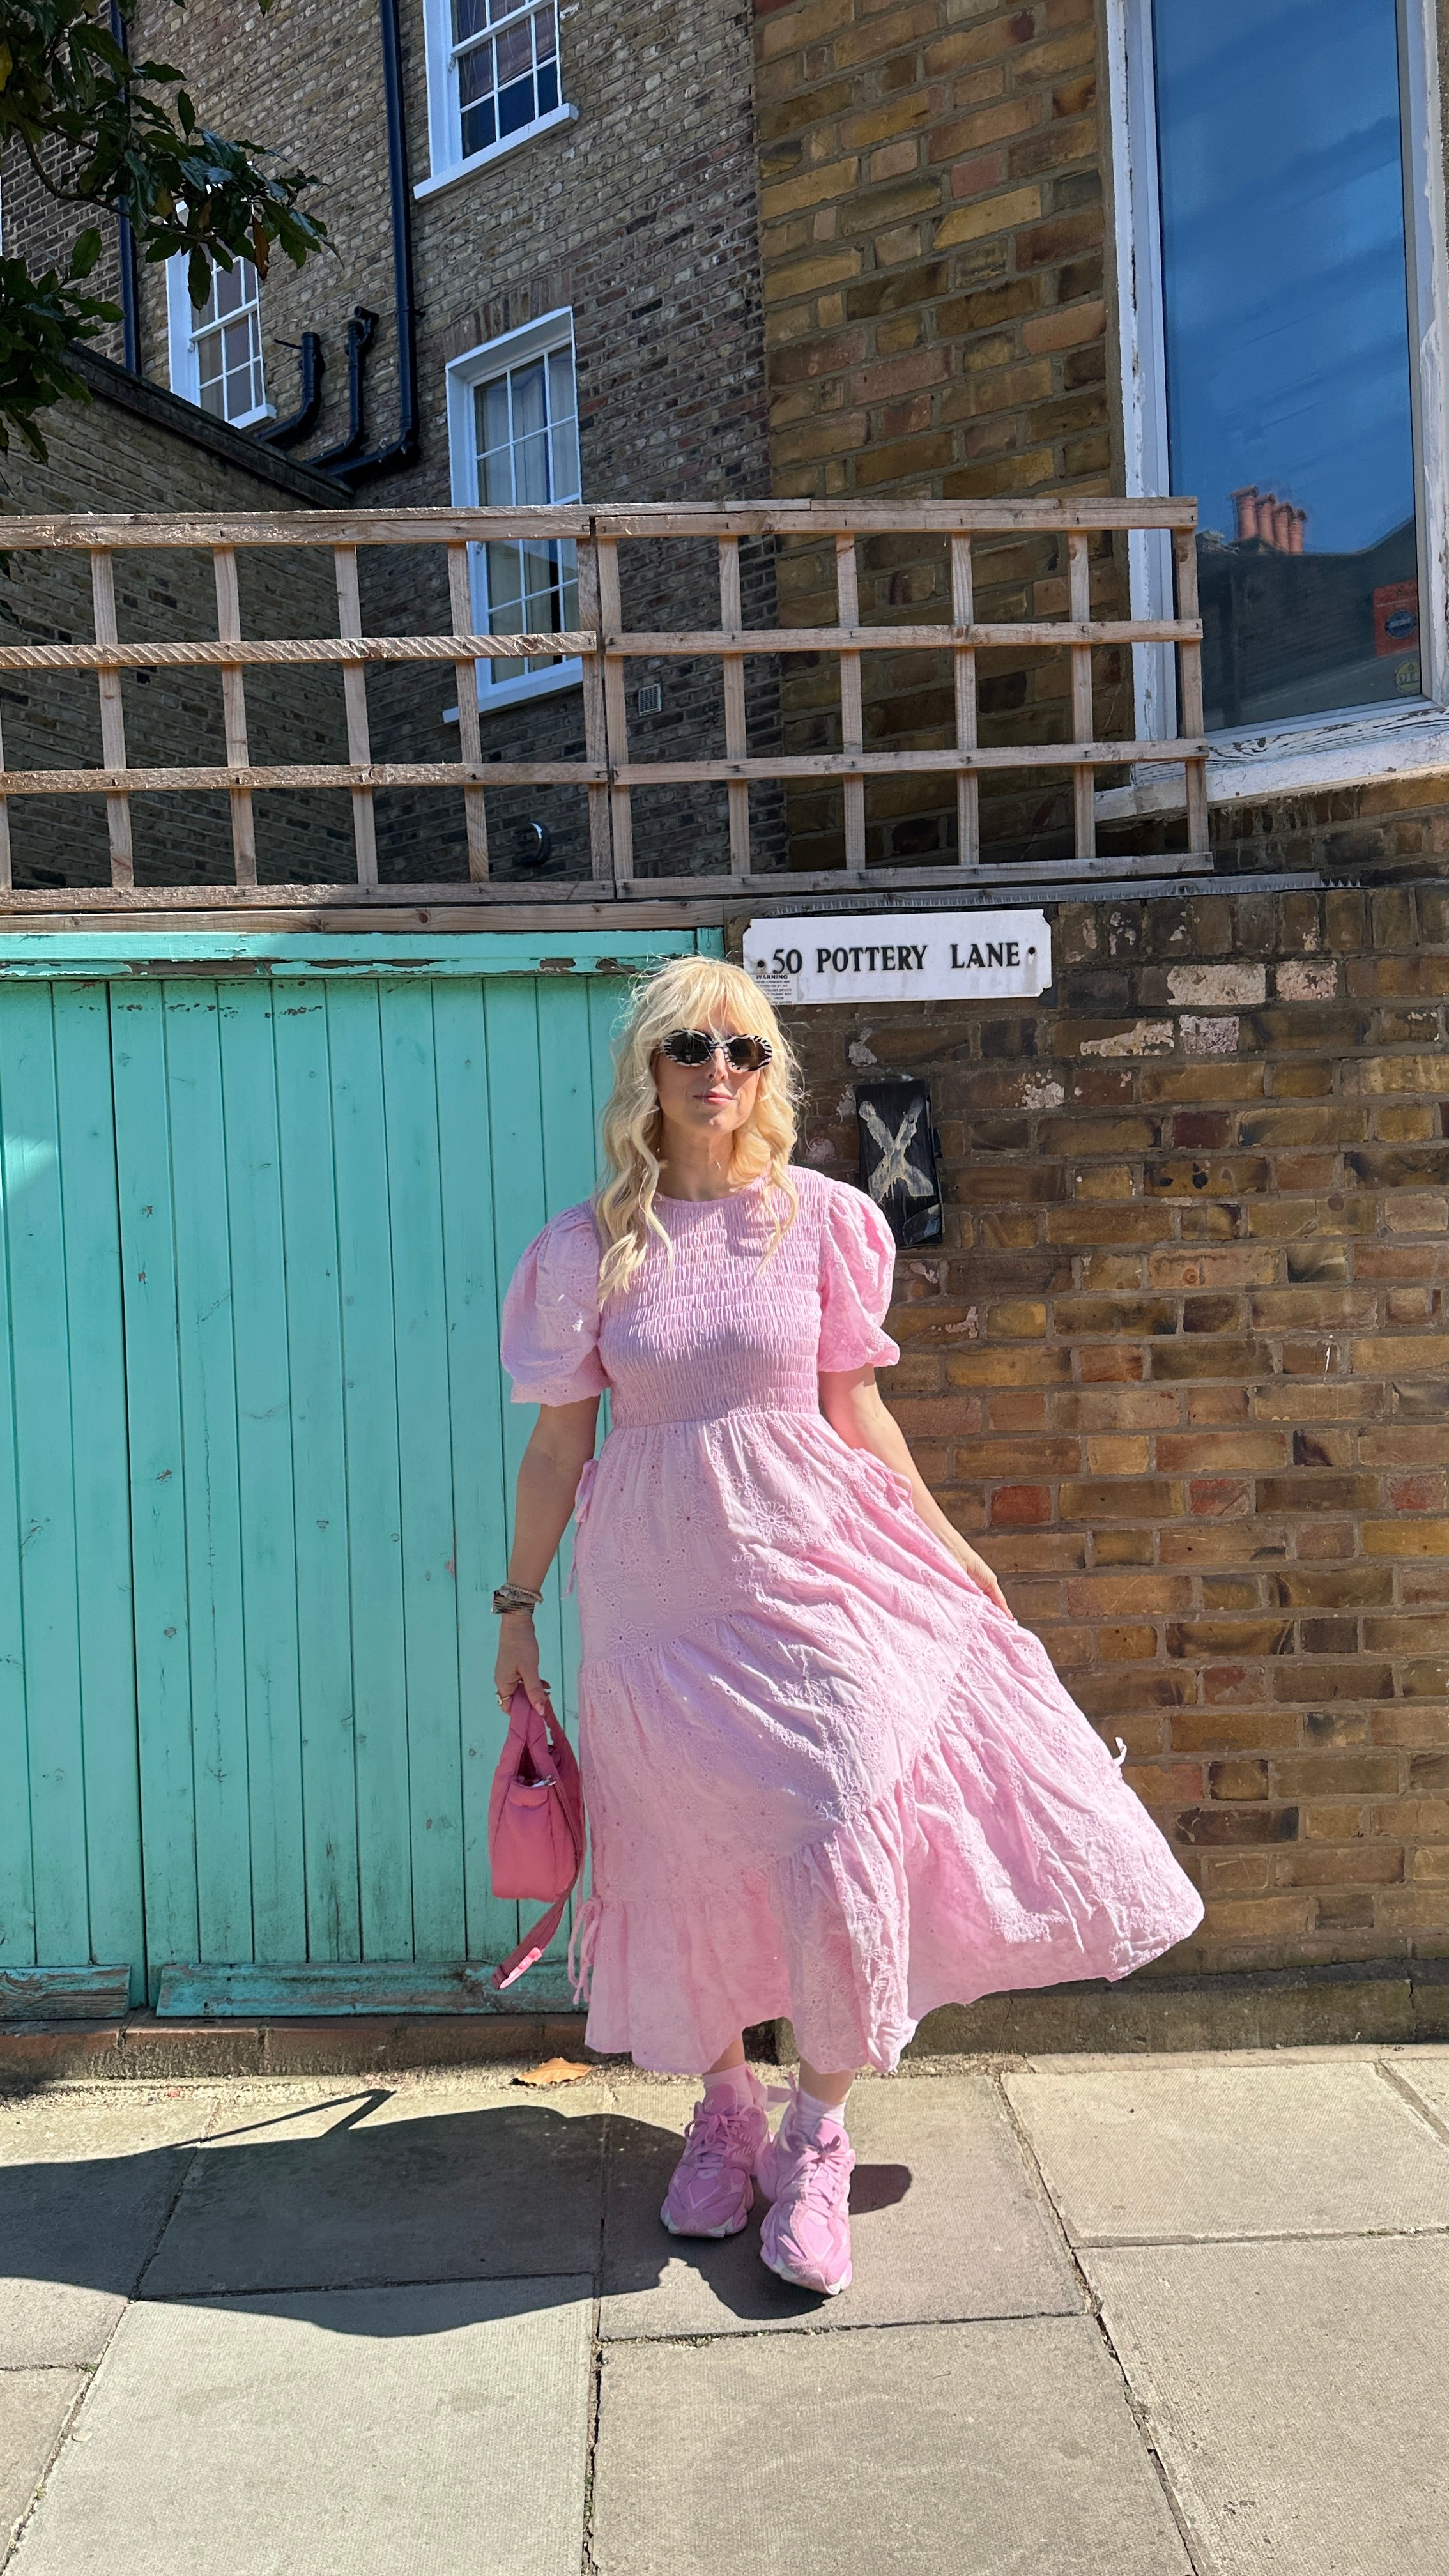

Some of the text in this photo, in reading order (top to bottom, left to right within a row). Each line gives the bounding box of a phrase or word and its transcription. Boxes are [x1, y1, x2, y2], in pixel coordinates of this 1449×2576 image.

[772, 942, 1020, 974] 50 POTTERY LANE
